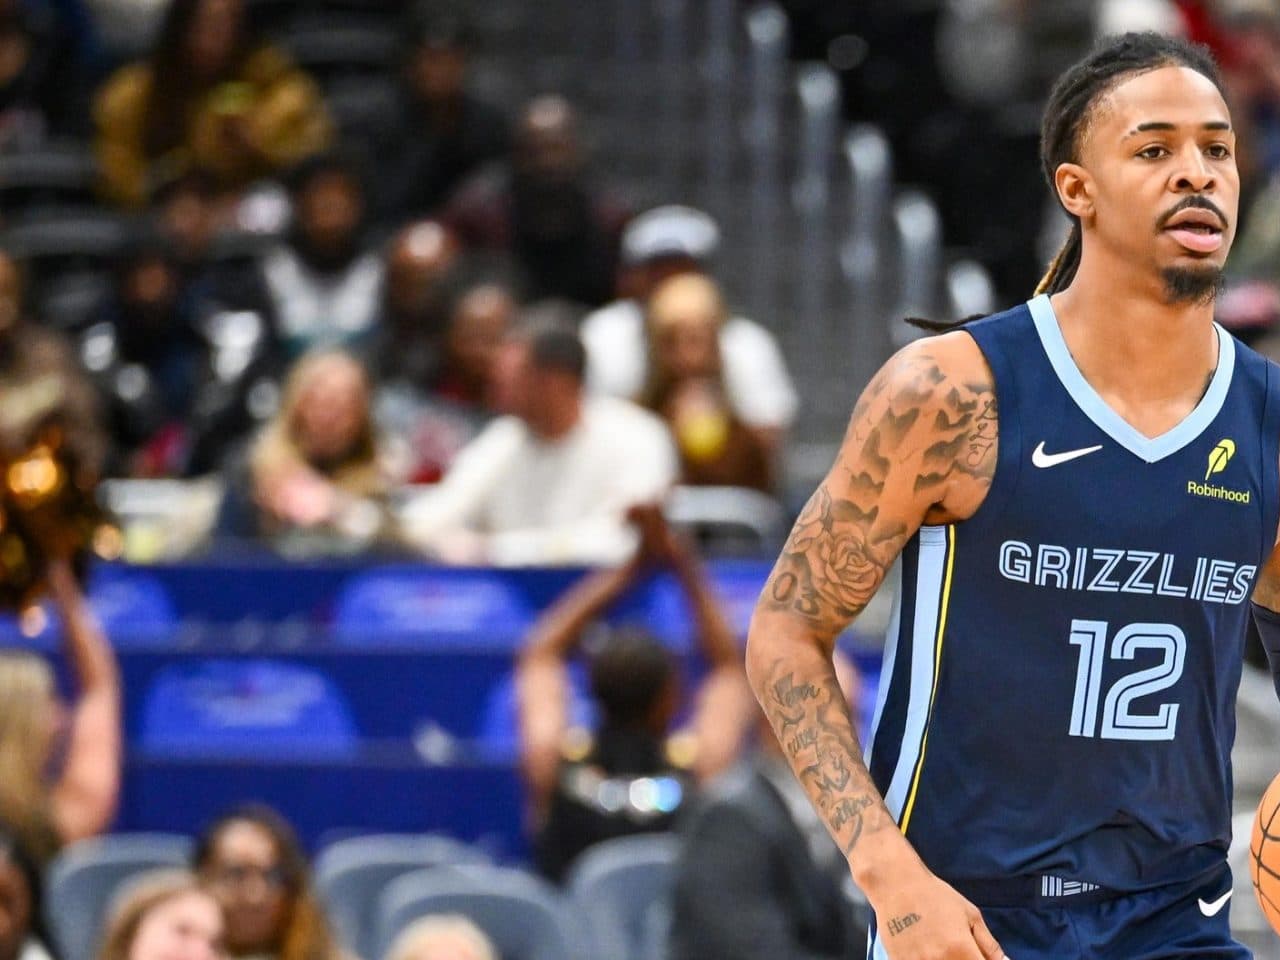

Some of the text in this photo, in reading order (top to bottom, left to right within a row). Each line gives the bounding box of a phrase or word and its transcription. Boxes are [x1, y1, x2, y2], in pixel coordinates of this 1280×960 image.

[1187, 481, 1250, 503] Robinhood
[999, 540, 1257, 605] GRIZZLIES
[1068, 619, 1187, 741] 12
